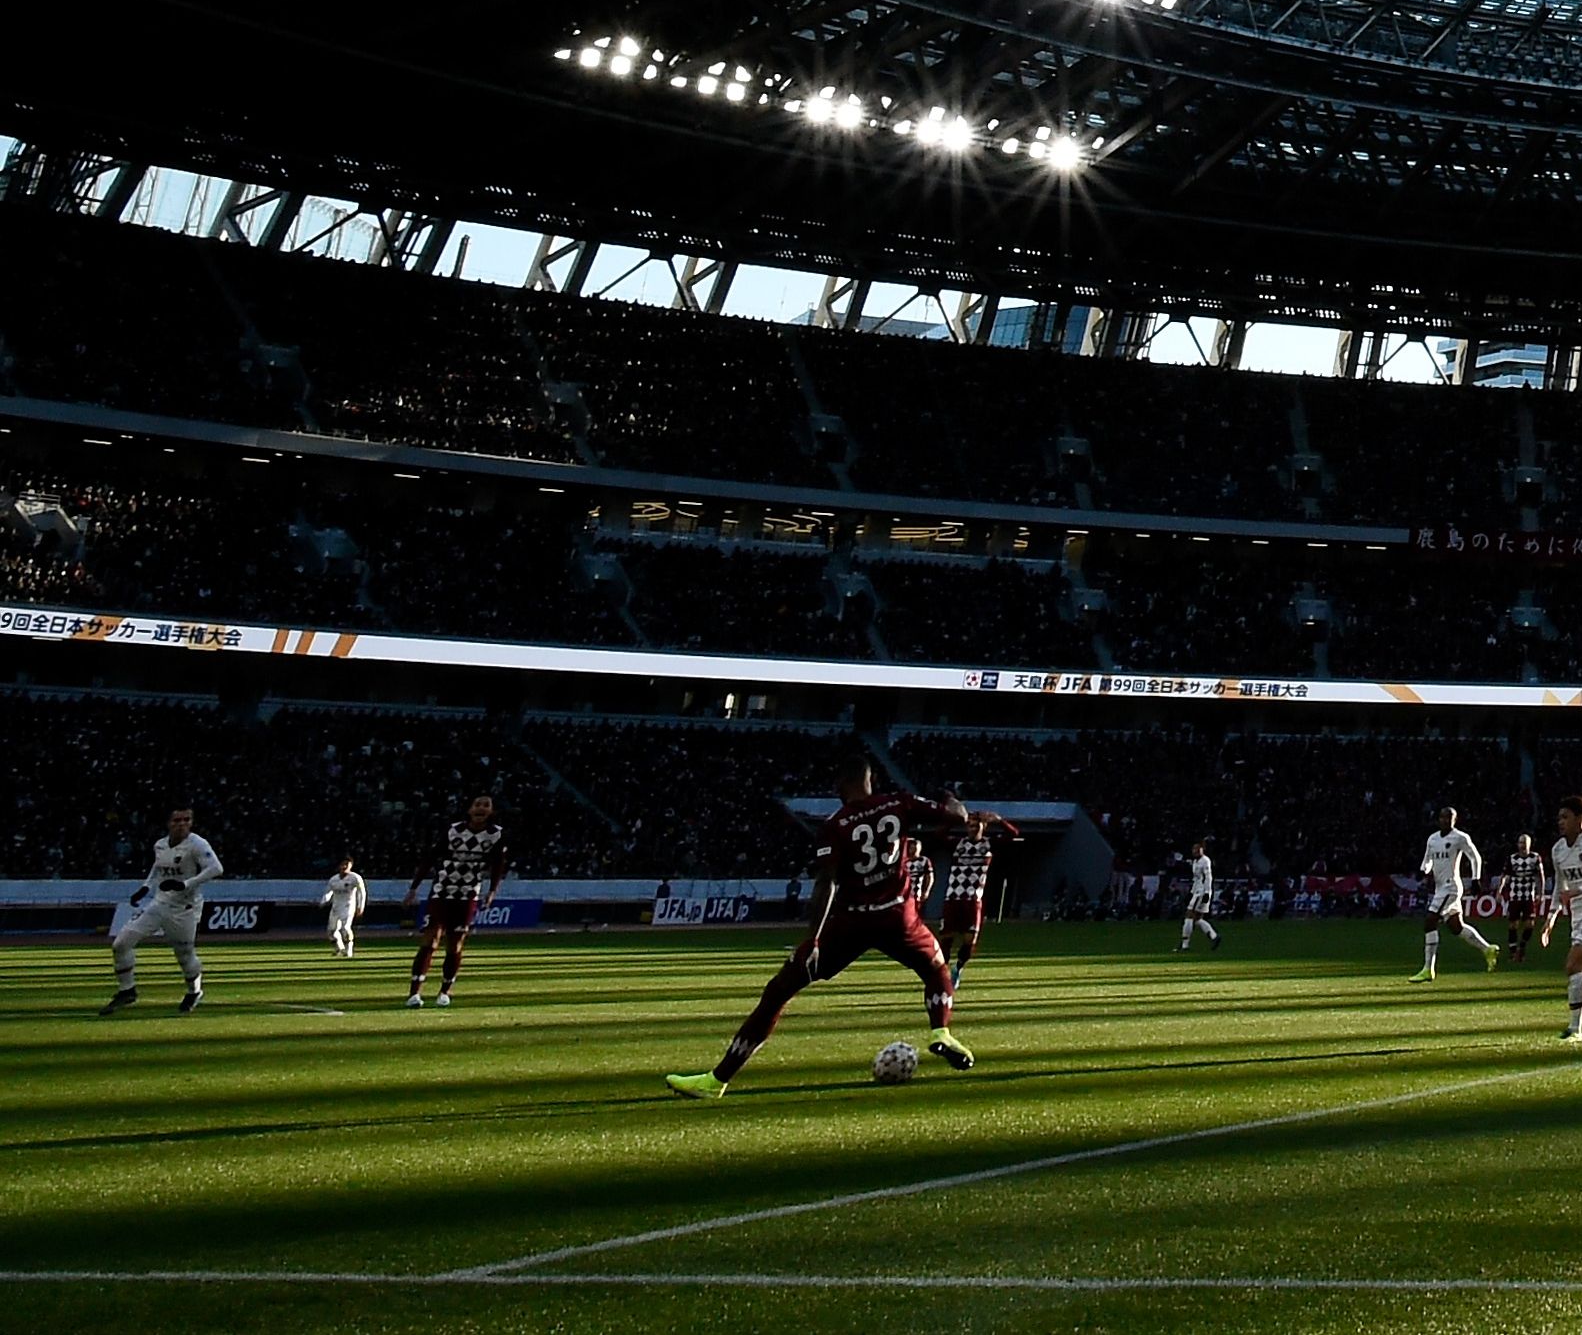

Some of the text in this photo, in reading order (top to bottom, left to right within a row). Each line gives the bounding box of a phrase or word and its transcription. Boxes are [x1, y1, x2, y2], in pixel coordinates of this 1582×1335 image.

[1013, 674, 1309, 698] 天皇杯 JFA 第99回全日本サッカー選手権大会
[852, 814, 901, 875] 33
[208, 905, 259, 930] SAVAS
[1462, 894, 1570, 917] TOYT
